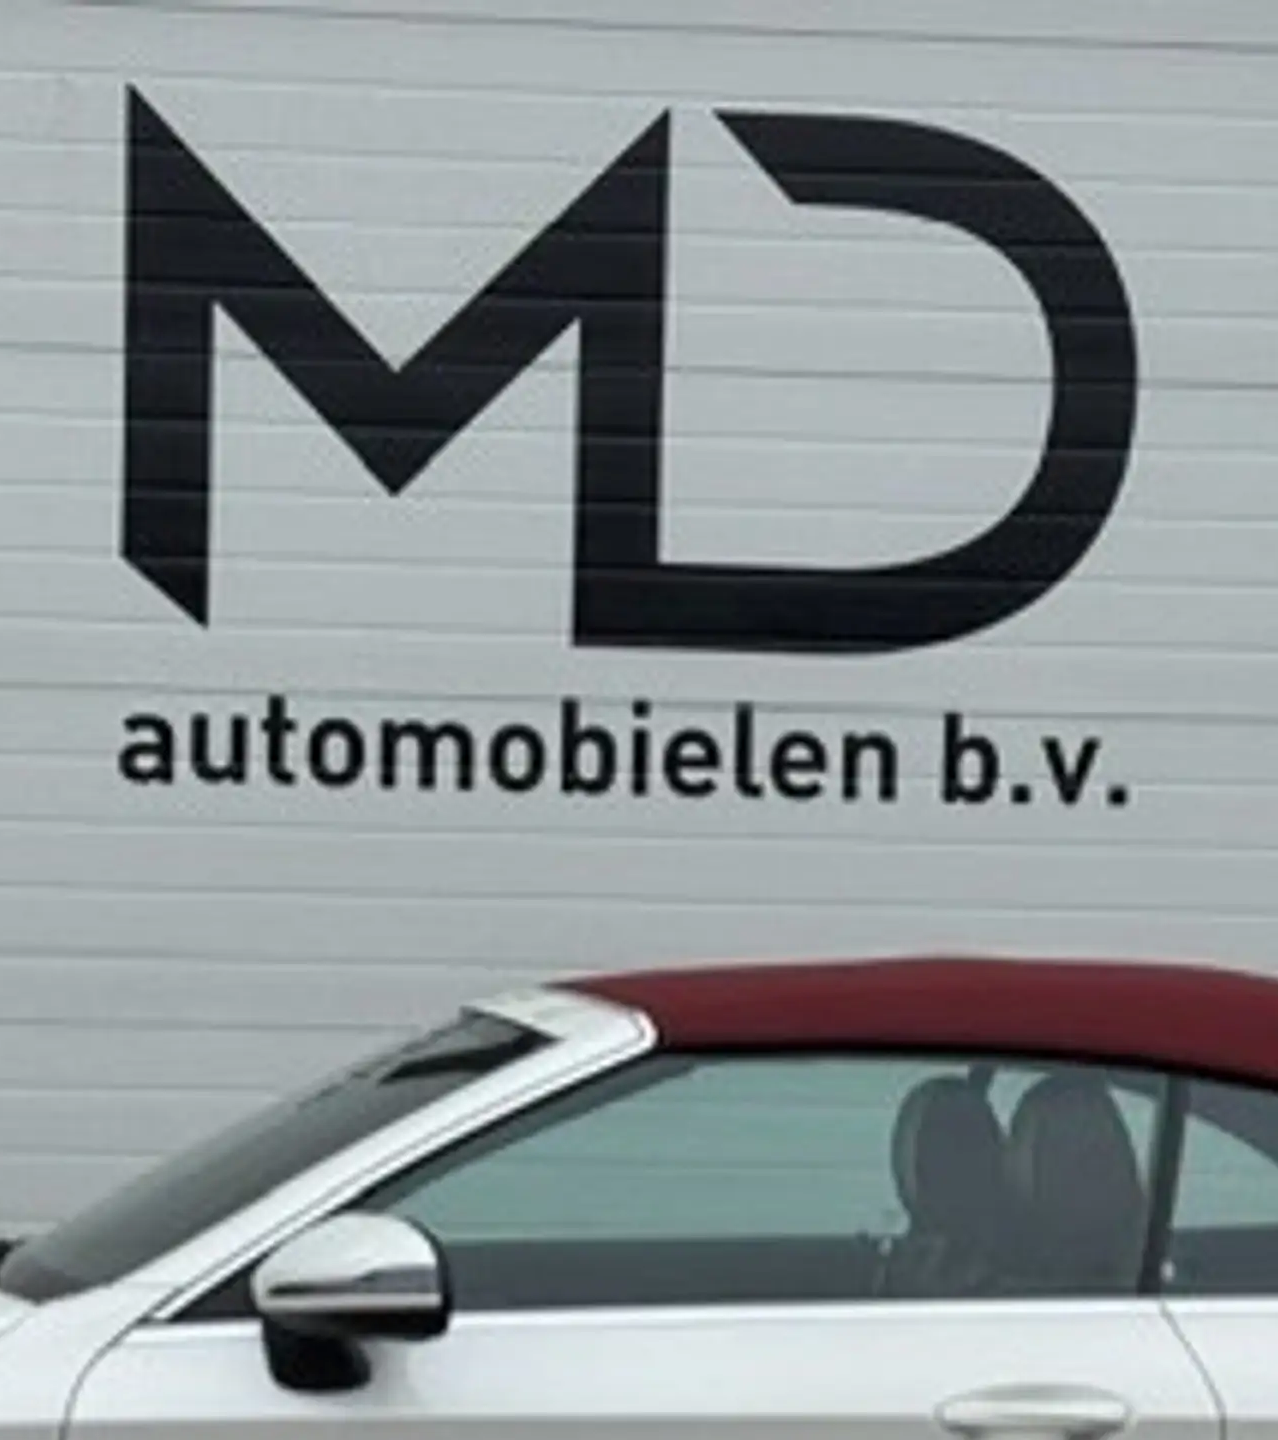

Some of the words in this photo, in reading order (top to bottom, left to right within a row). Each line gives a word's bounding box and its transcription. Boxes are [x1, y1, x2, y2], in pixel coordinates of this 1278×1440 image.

[121, 84, 1138, 655] MD
[119, 695, 898, 802] automobielen
[941, 711, 1129, 807] b.v.
